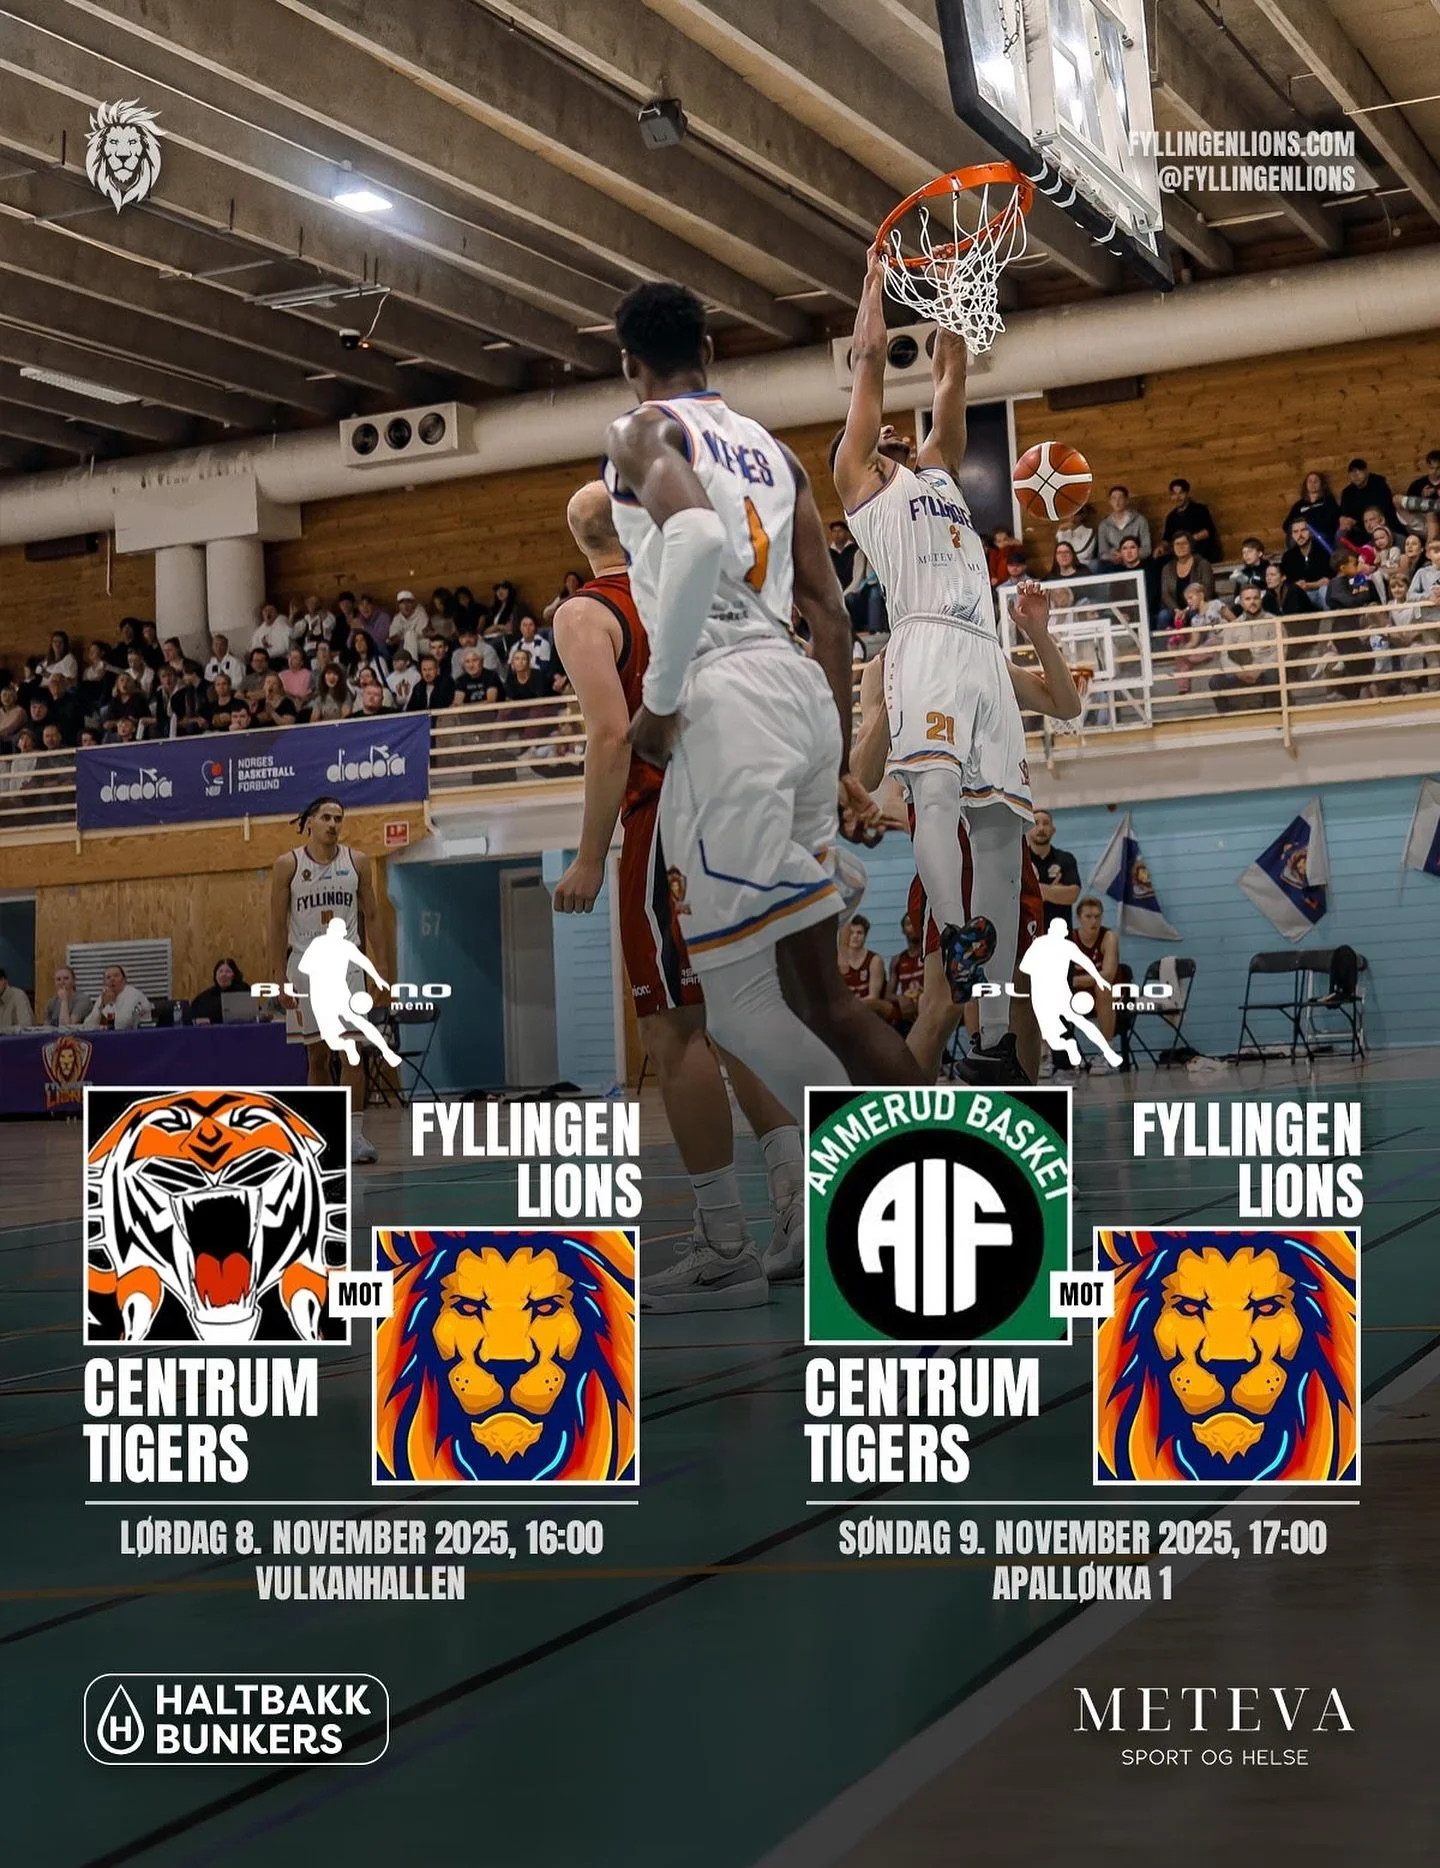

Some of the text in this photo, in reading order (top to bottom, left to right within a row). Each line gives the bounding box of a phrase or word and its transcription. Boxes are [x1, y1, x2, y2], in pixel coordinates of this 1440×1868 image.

[926, 711, 956, 745] 21
[237, 756, 274, 769] NORGES
[237, 766, 296, 781] BASKETBALL
[326, 745, 406, 784] diadora
[100, 768, 173, 803] diadora
[237, 779, 281, 792] FORBUND
